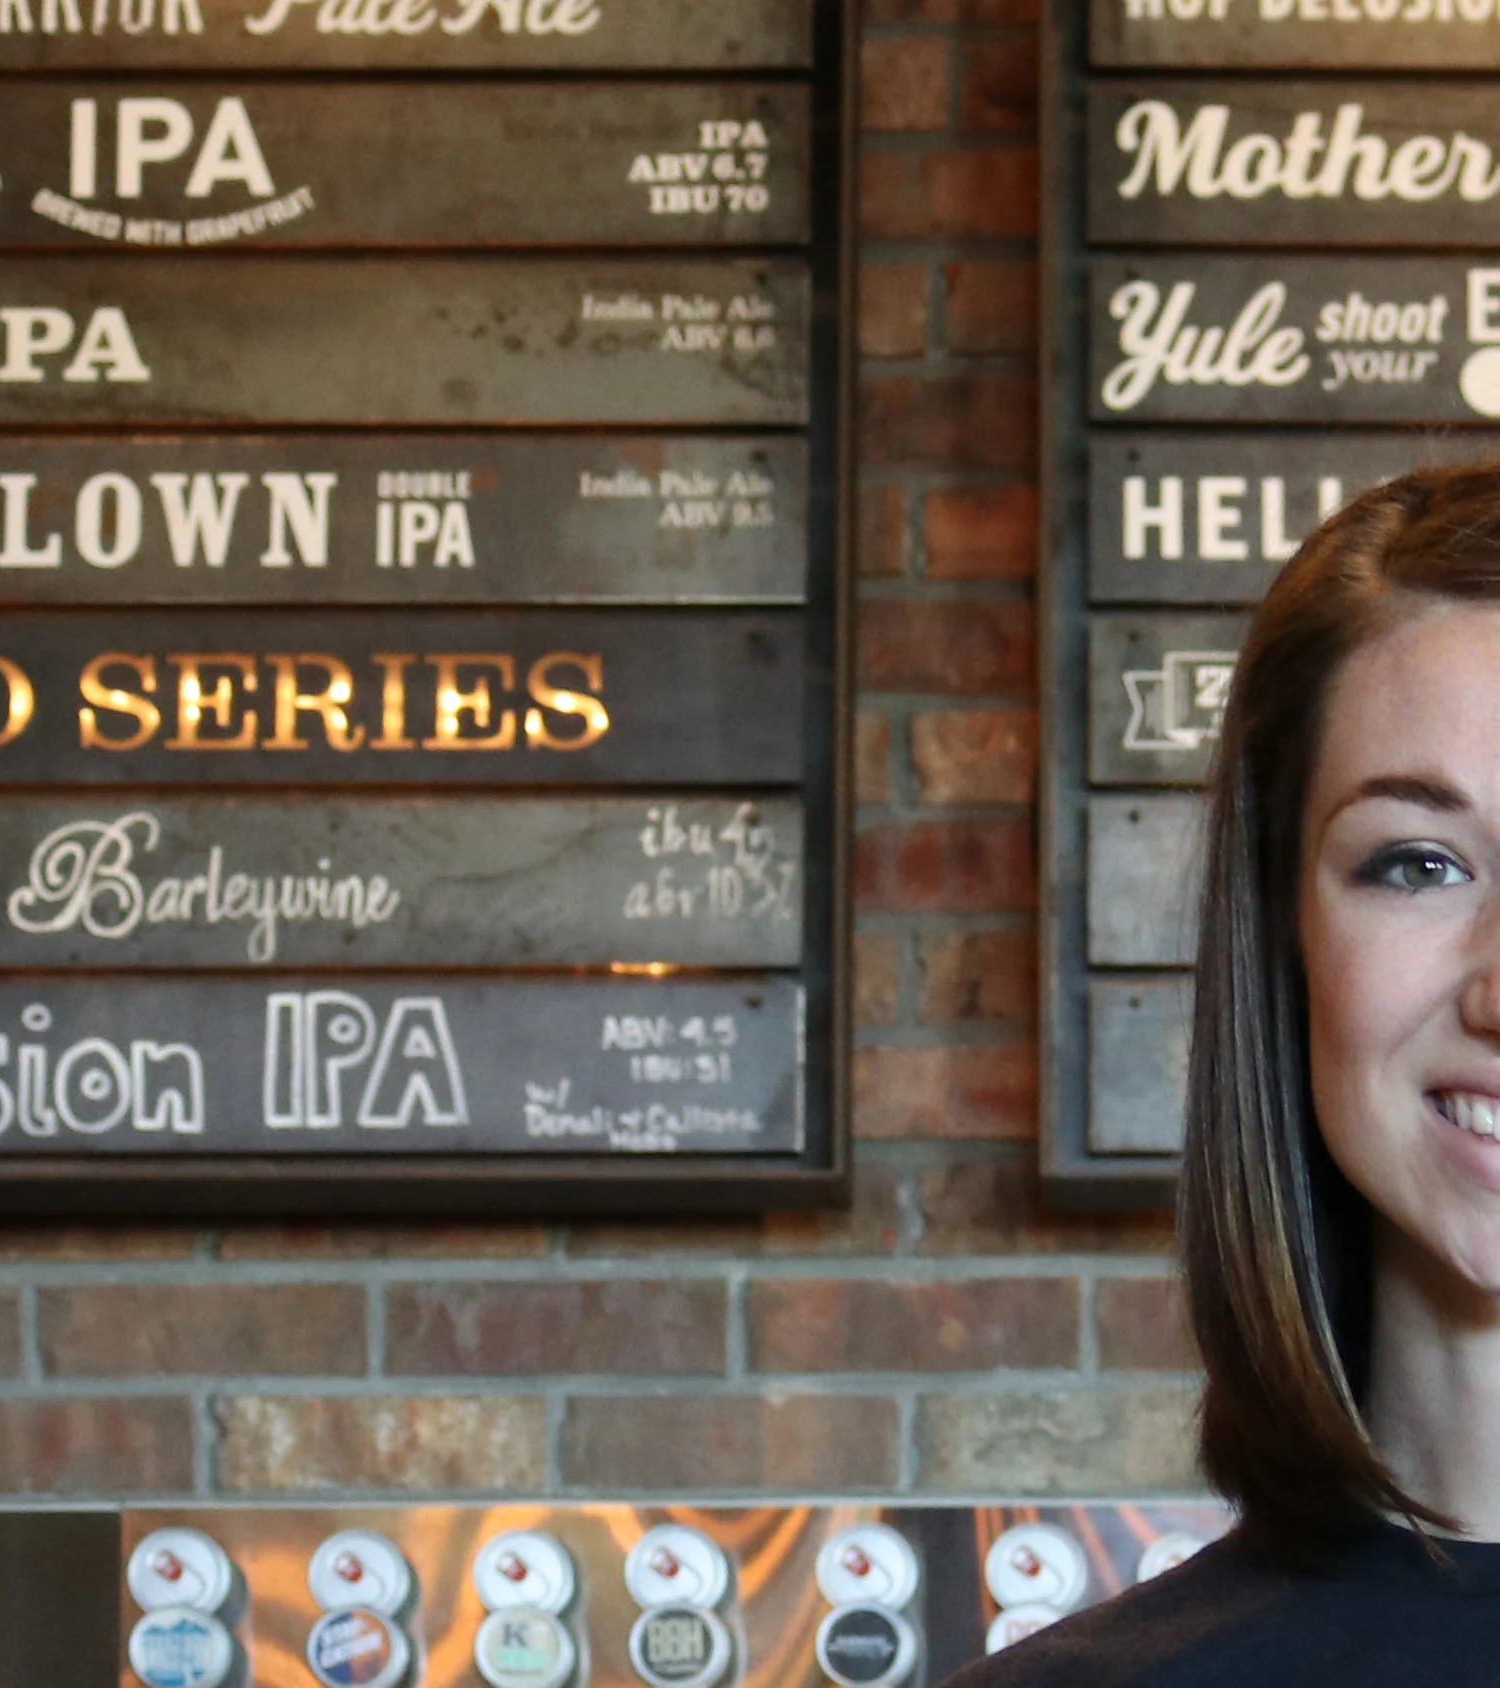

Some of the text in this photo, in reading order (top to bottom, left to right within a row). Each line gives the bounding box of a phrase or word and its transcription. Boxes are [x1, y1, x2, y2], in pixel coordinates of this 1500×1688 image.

[69, 97, 276, 198] IPA
[628, 152, 710, 184] ABV
[699, 119, 769, 150] IPA
[649, 185, 770, 215] IBU 70
[1100, 281, 1311, 413] Yule
[1316, 293, 1449, 345] shoot
[1321, 348, 1440, 392] your
[374, 501, 477, 569] IPA
[78, 652, 611, 753] SERIES
[7, 811, 402, 963] Barleywine
[262, 989, 469, 1129] IPA
